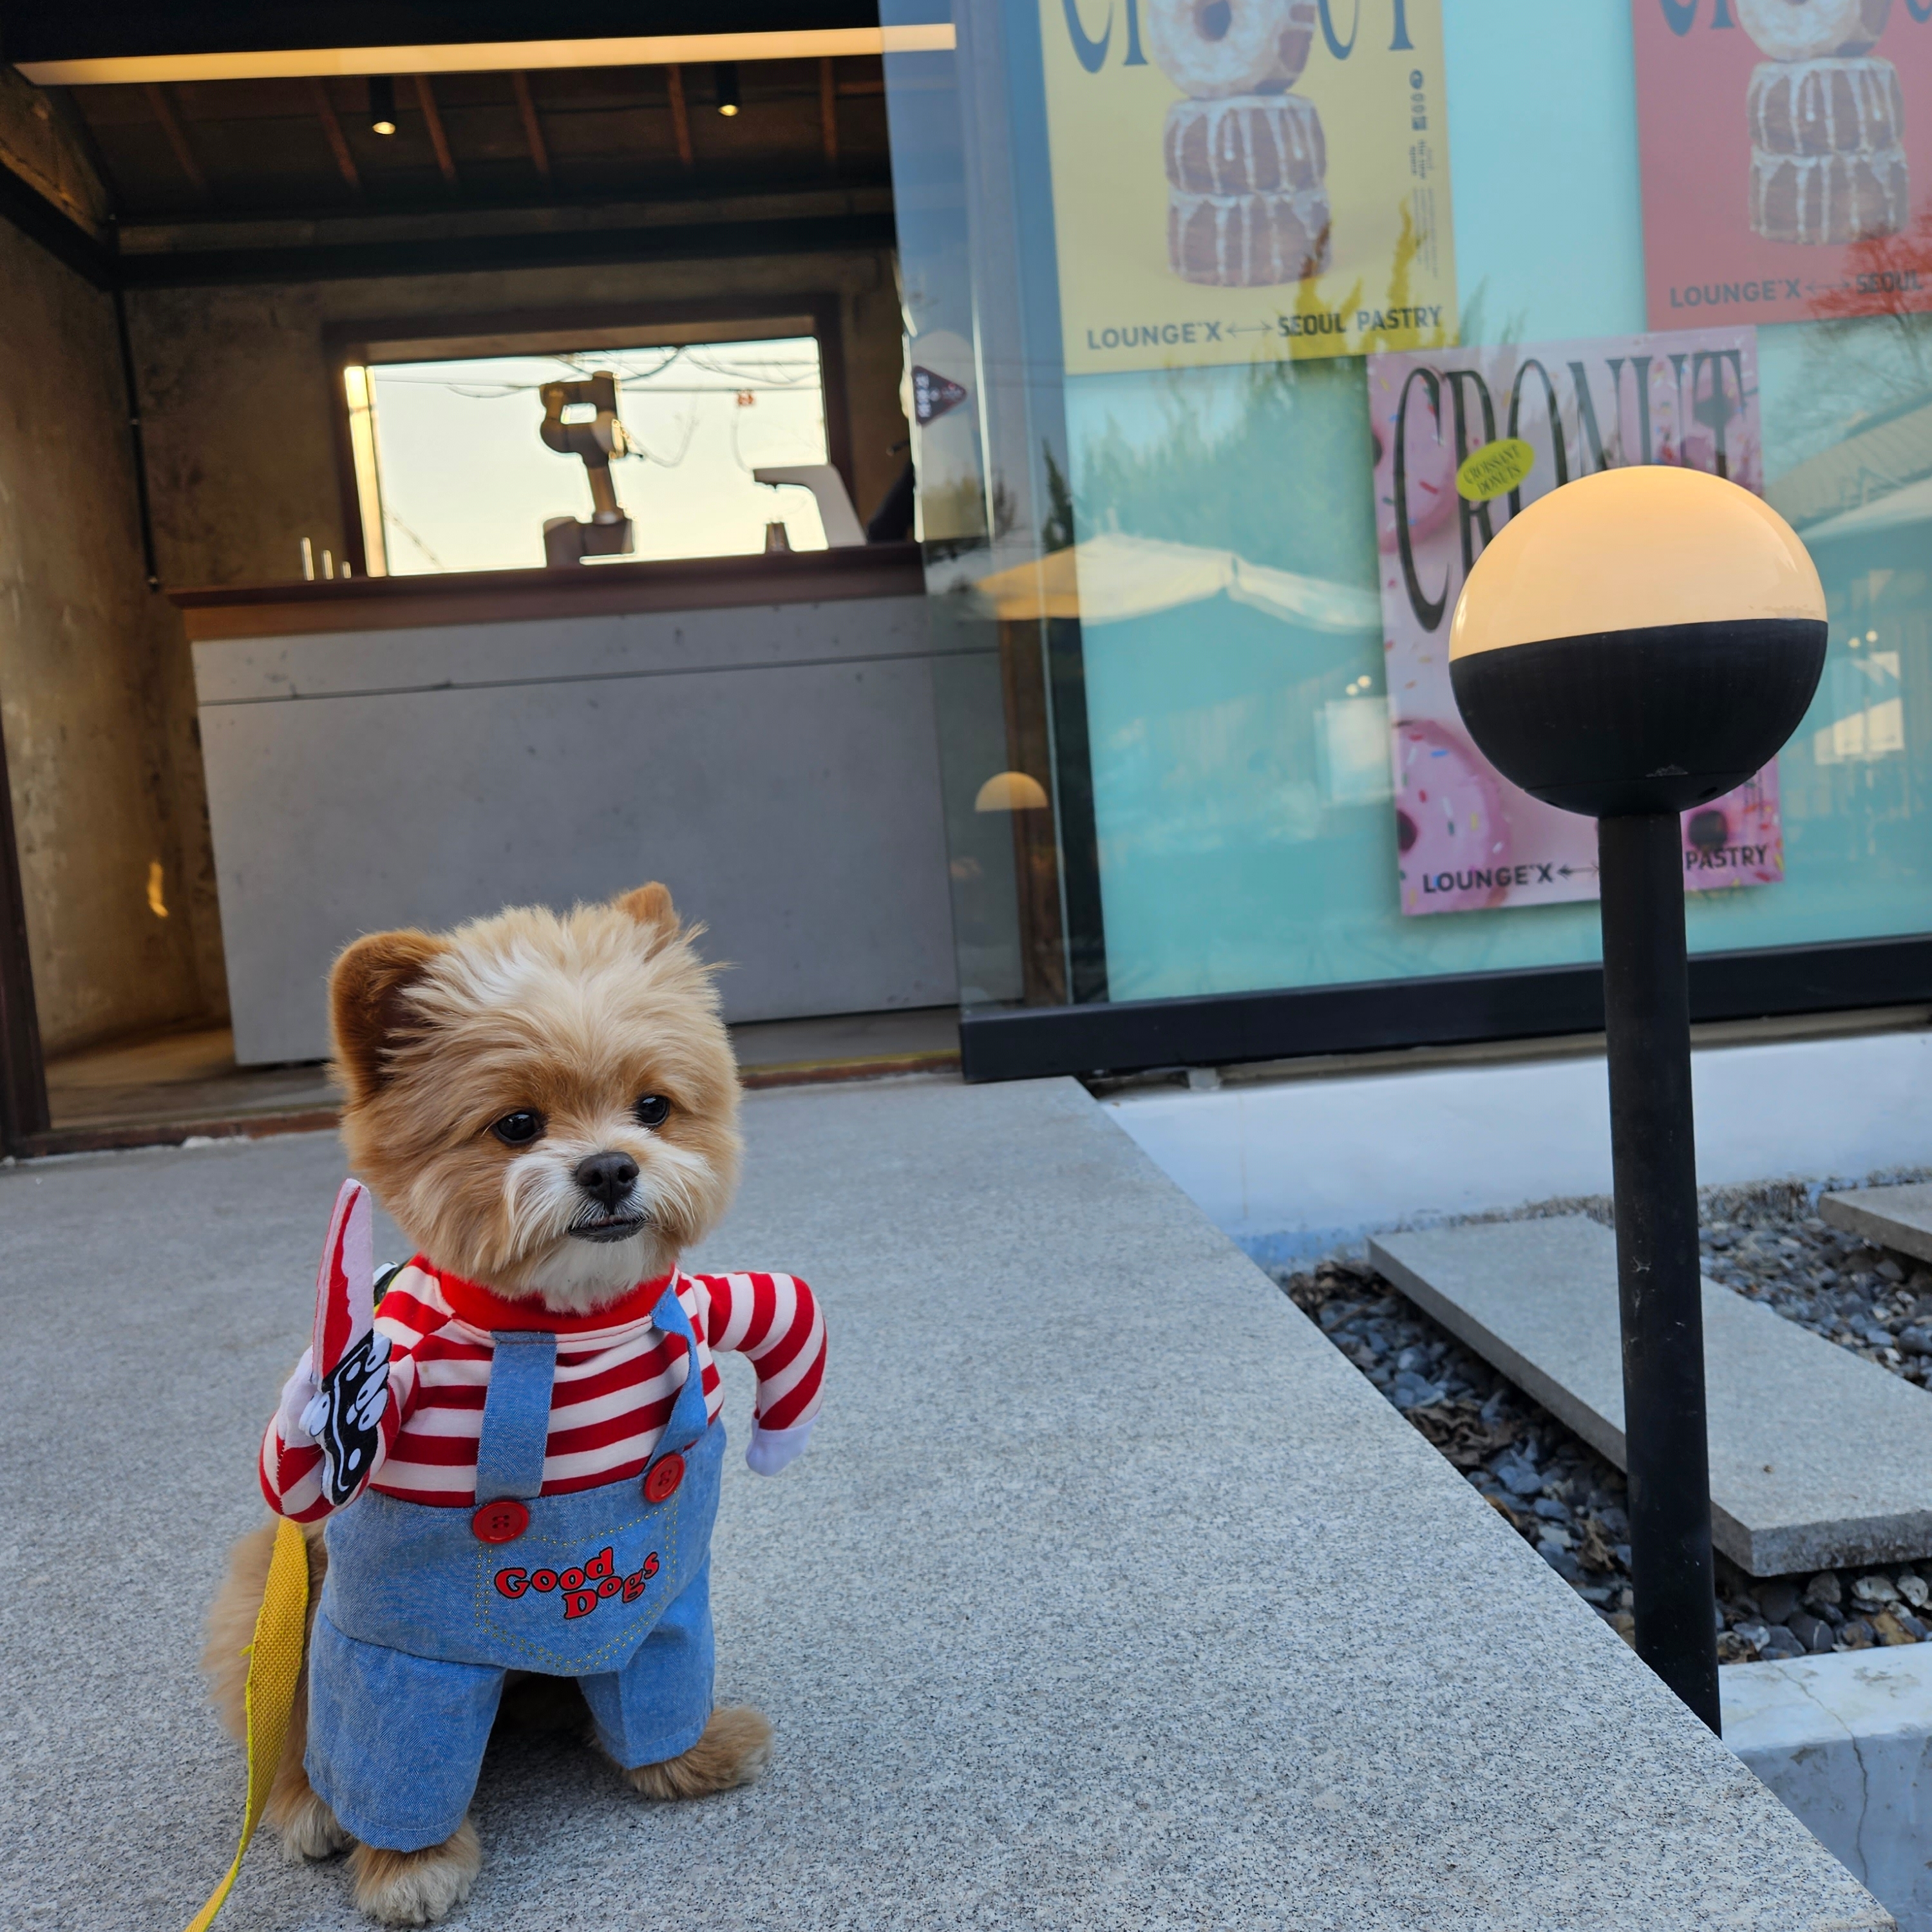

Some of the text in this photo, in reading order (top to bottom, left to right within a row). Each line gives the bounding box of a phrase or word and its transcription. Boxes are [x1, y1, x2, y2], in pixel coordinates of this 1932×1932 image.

[1856, 268, 1924, 295] SEOUL
[1278, 313, 1347, 337] SEOUL
[1356, 305, 1443, 332] PASTRY
[1685, 844, 1768, 871] PASTRY
[494, 1546, 614, 1599] Good
[562, 1551, 660, 1619] Dogs
